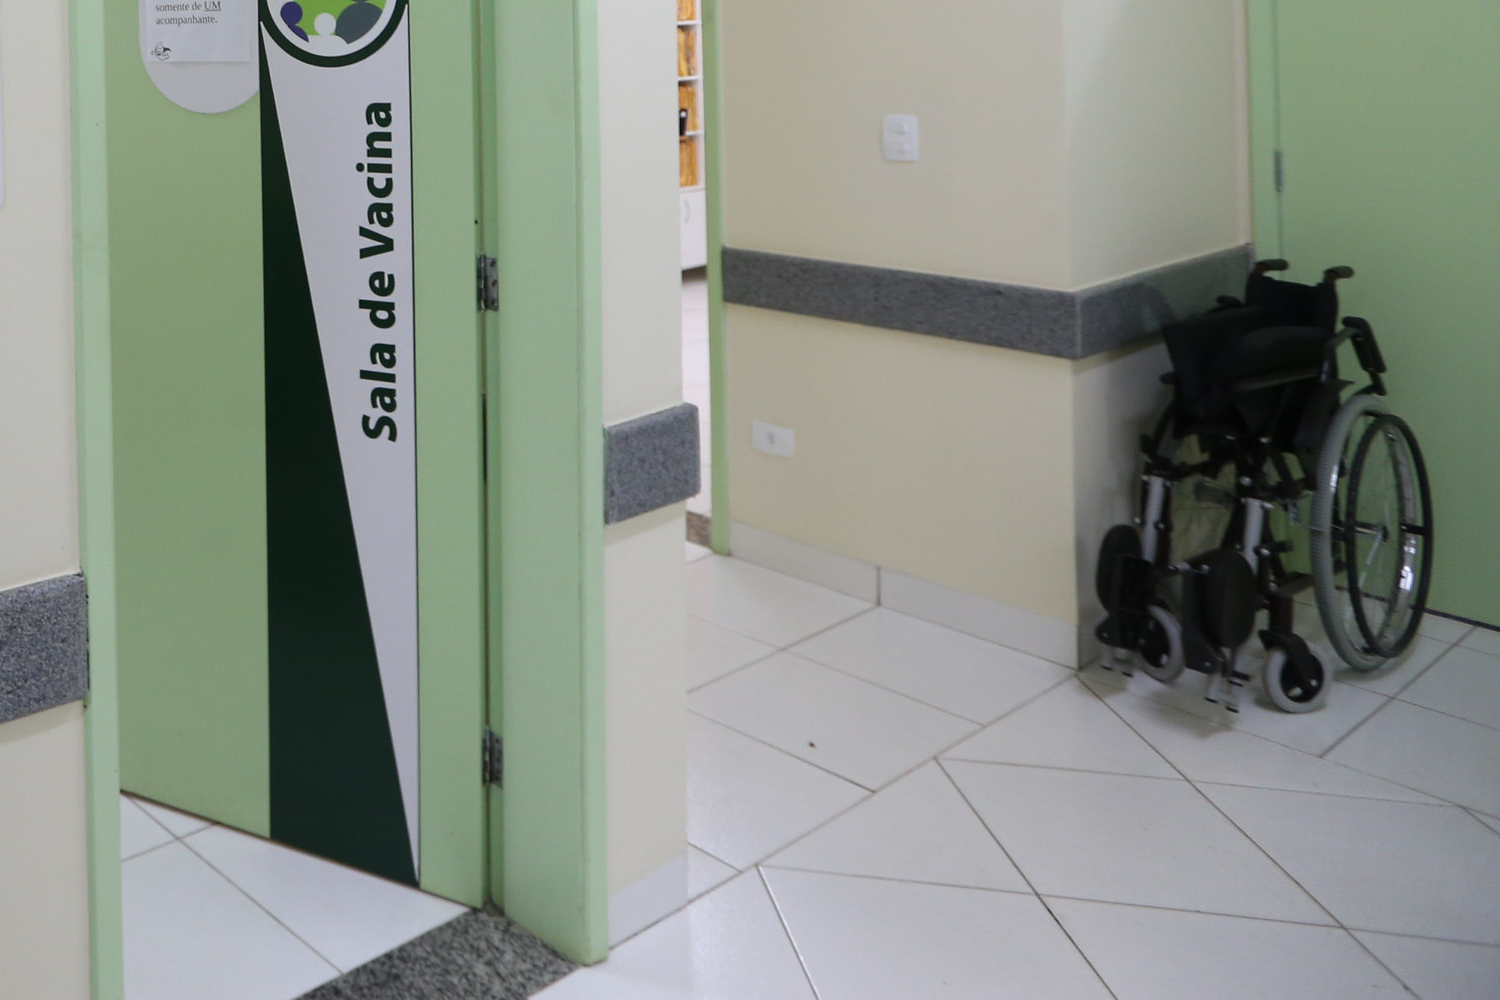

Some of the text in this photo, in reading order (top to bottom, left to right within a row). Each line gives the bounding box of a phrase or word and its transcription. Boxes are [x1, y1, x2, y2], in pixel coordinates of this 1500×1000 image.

[156, 1, 221, 12] somente de UM
[156, 15, 218, 26] acompanhante.
[356, 103, 397, 442] Sala de Vacina
